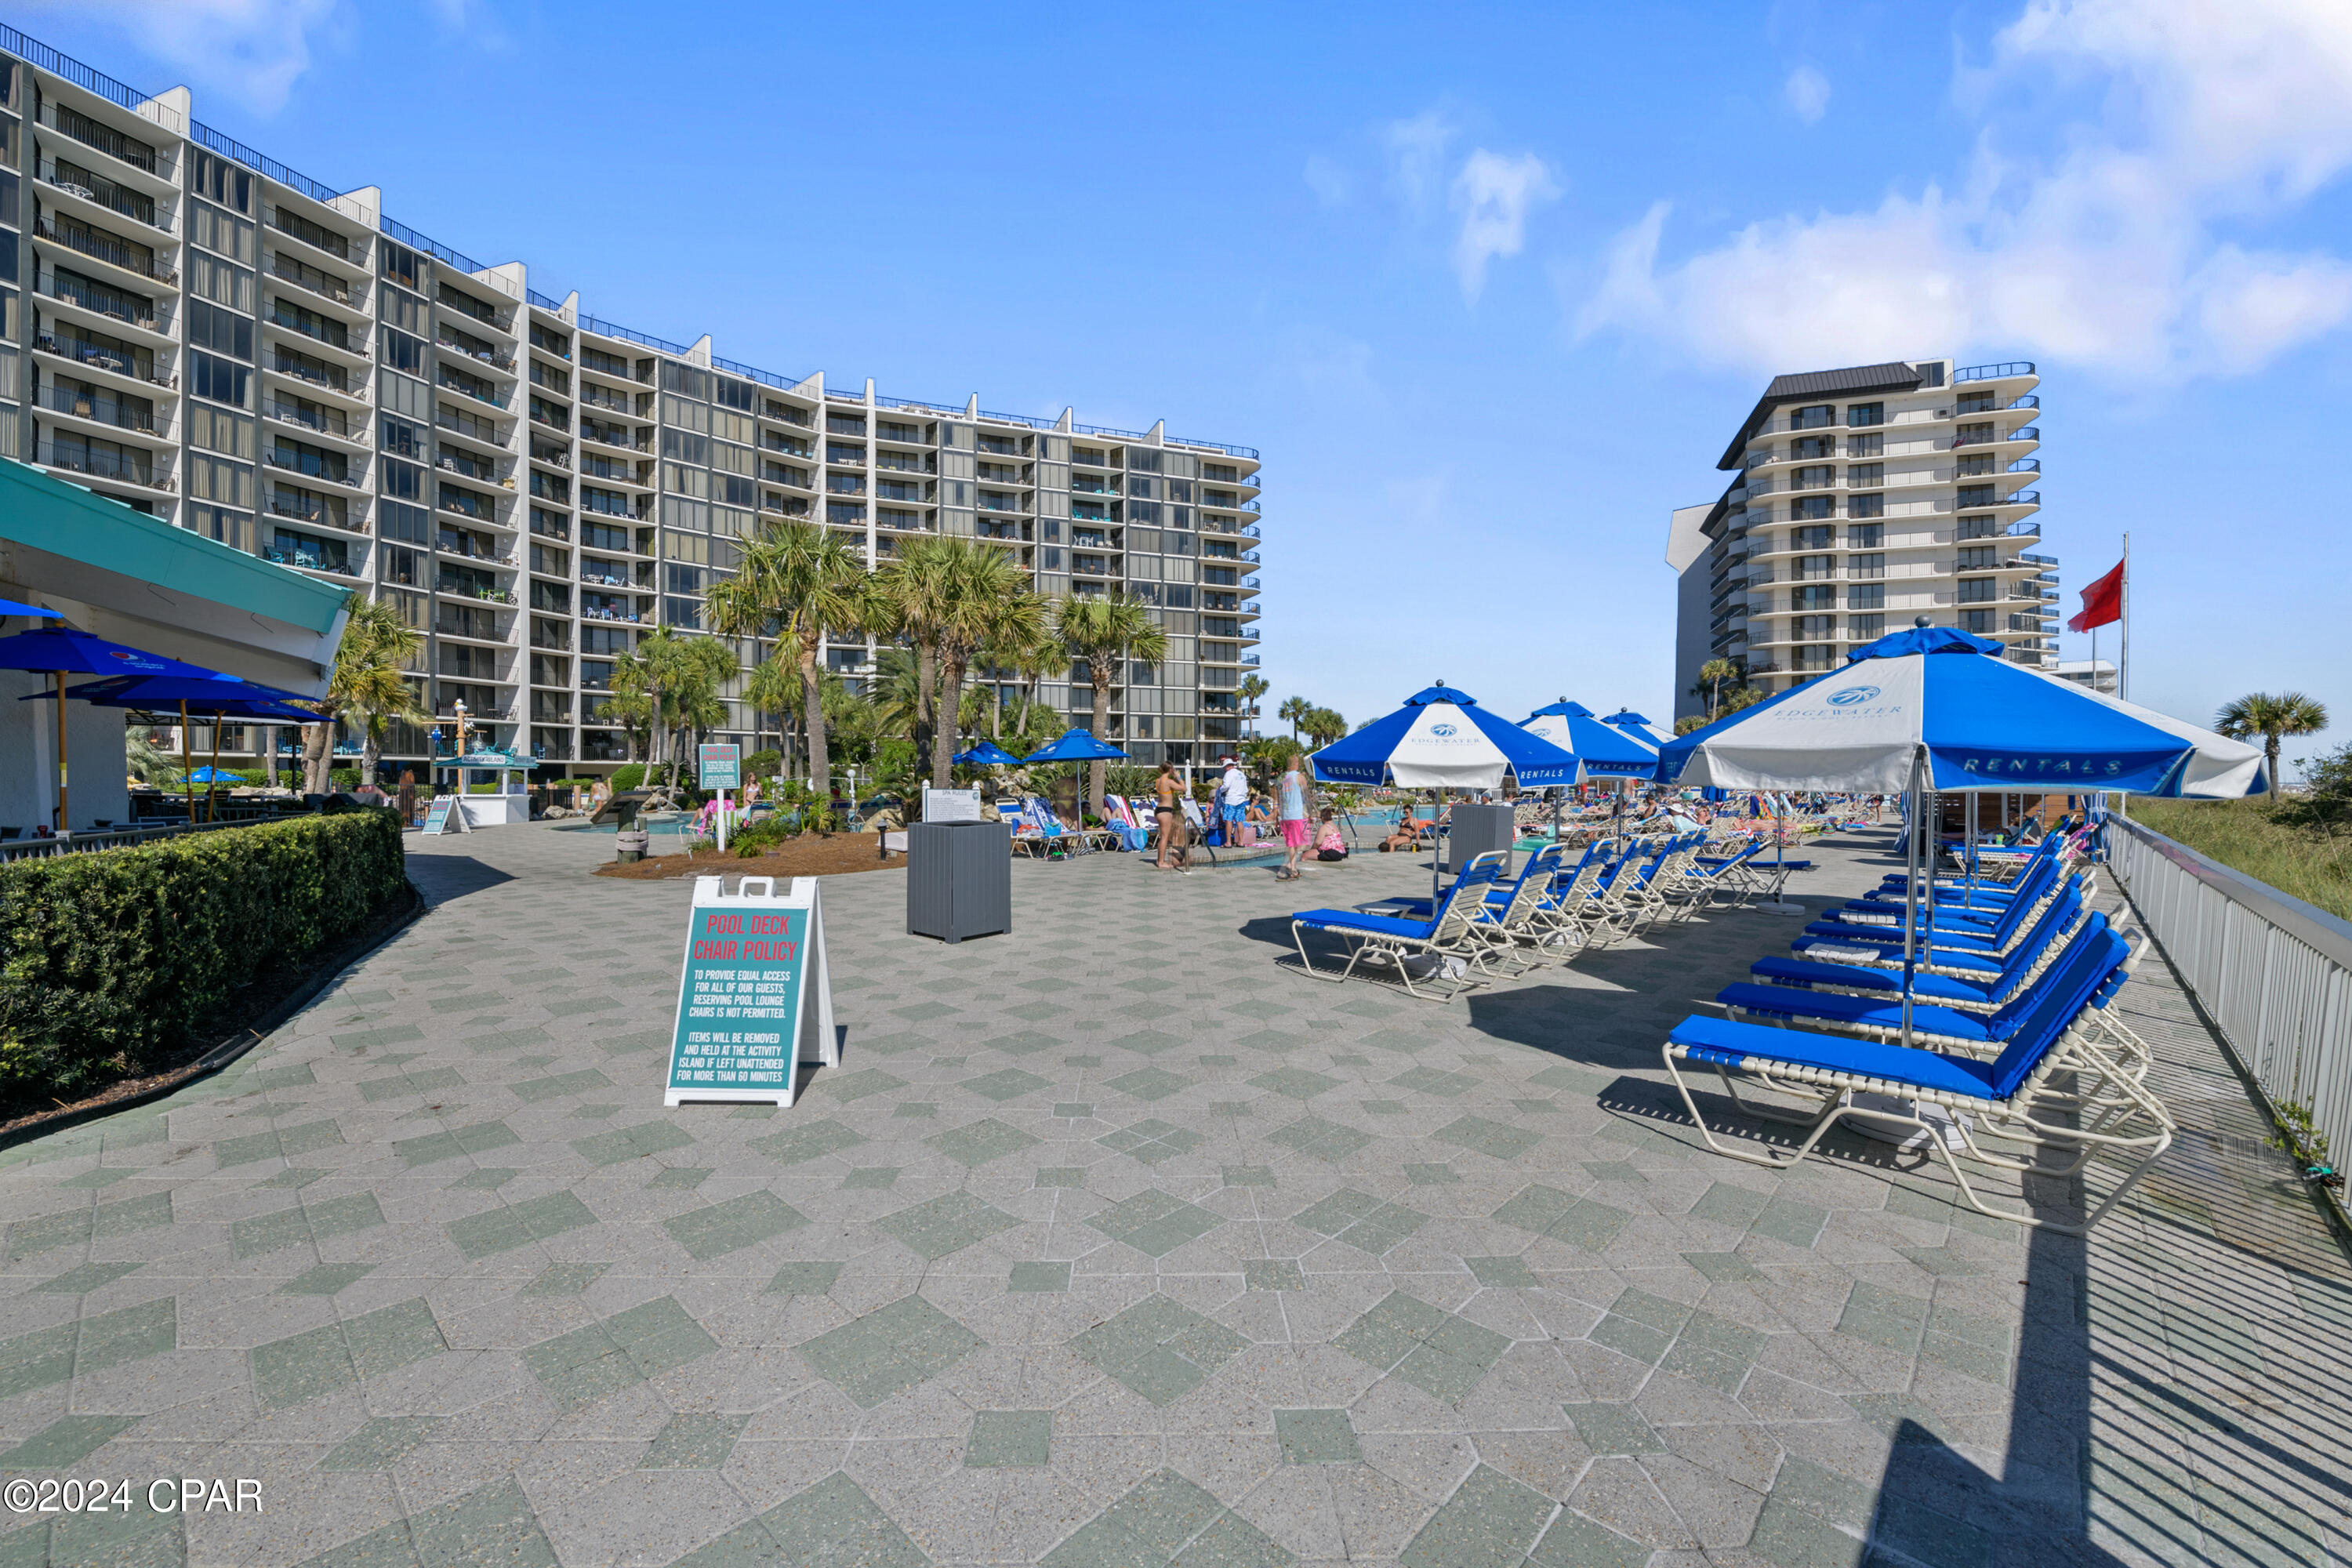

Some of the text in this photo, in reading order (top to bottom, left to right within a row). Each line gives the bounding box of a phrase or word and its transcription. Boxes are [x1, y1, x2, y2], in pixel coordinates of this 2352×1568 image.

[1775, 706, 1902, 716] EDGEWATER
[1327, 767, 1375, 777] RENTALS
[1963, 758, 2123, 775] RENTALS
[1520, 769, 1564, 779] RENTALS
[706, 915, 790, 935] POOL DECK
[694, 939, 798, 961] CHAIR POLICY
[694, 970, 791, 981] TO PROVIDE EQUAL ACCESS
[695, 982, 786, 994] FOR ALL OF OUR GUESTS,
[693, 994, 785, 1006] RESERVING POOL LOUNGE
[689, 1007, 786, 1018] CHAIRS IS NOT PERMITTED.
[688, 1032, 780, 1044] ITEMS WILL BE REMOVED
[683, 1045, 782, 1056] AND HELD AT THE ACTIVITY
[678, 1057, 784, 1069] ISLAND IF LEFT UNATTENDED
[677, 1070, 783, 1082] FOR MORE THAN 60 MINUTES
